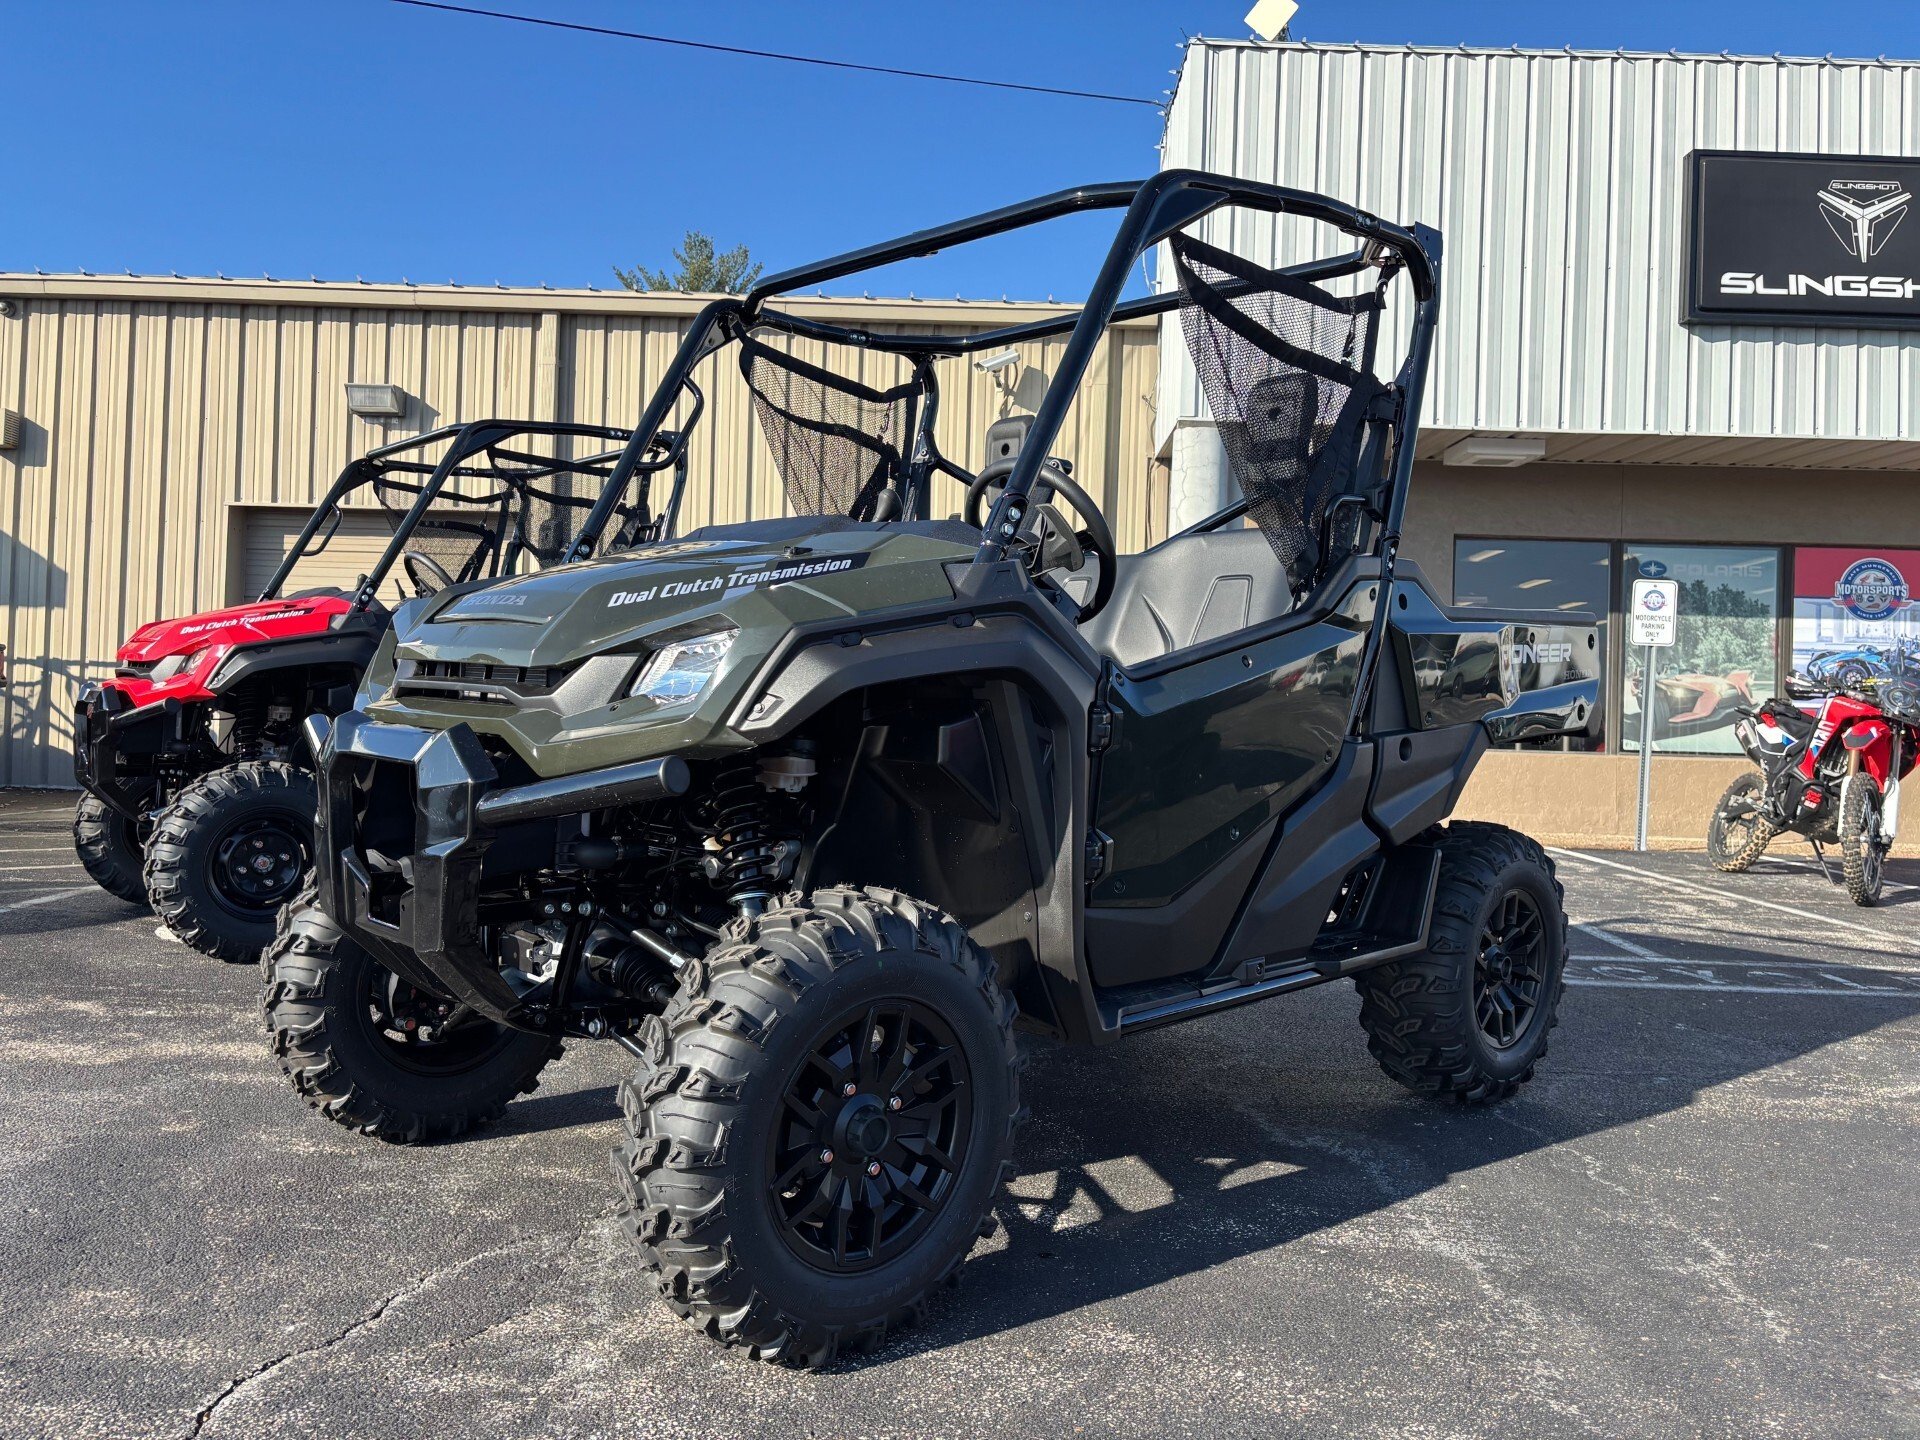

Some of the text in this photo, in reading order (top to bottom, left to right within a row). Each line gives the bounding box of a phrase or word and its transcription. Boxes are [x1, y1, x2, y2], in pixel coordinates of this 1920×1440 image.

[1831, 182, 1898, 191] SLINGSHOT
[1673, 564, 1763, 578] POLARIS
[607, 558, 852, 608] Dual Clutch Transmission
[1836, 583, 1907, 597] MOTORSPORTS
[462, 595, 528, 607] HONDA
[180, 610, 305, 635] Dual Clutch Transmission
[1635, 614, 1672, 623] MOTORCYCLE
[1641, 622, 1665, 630] PARKING
